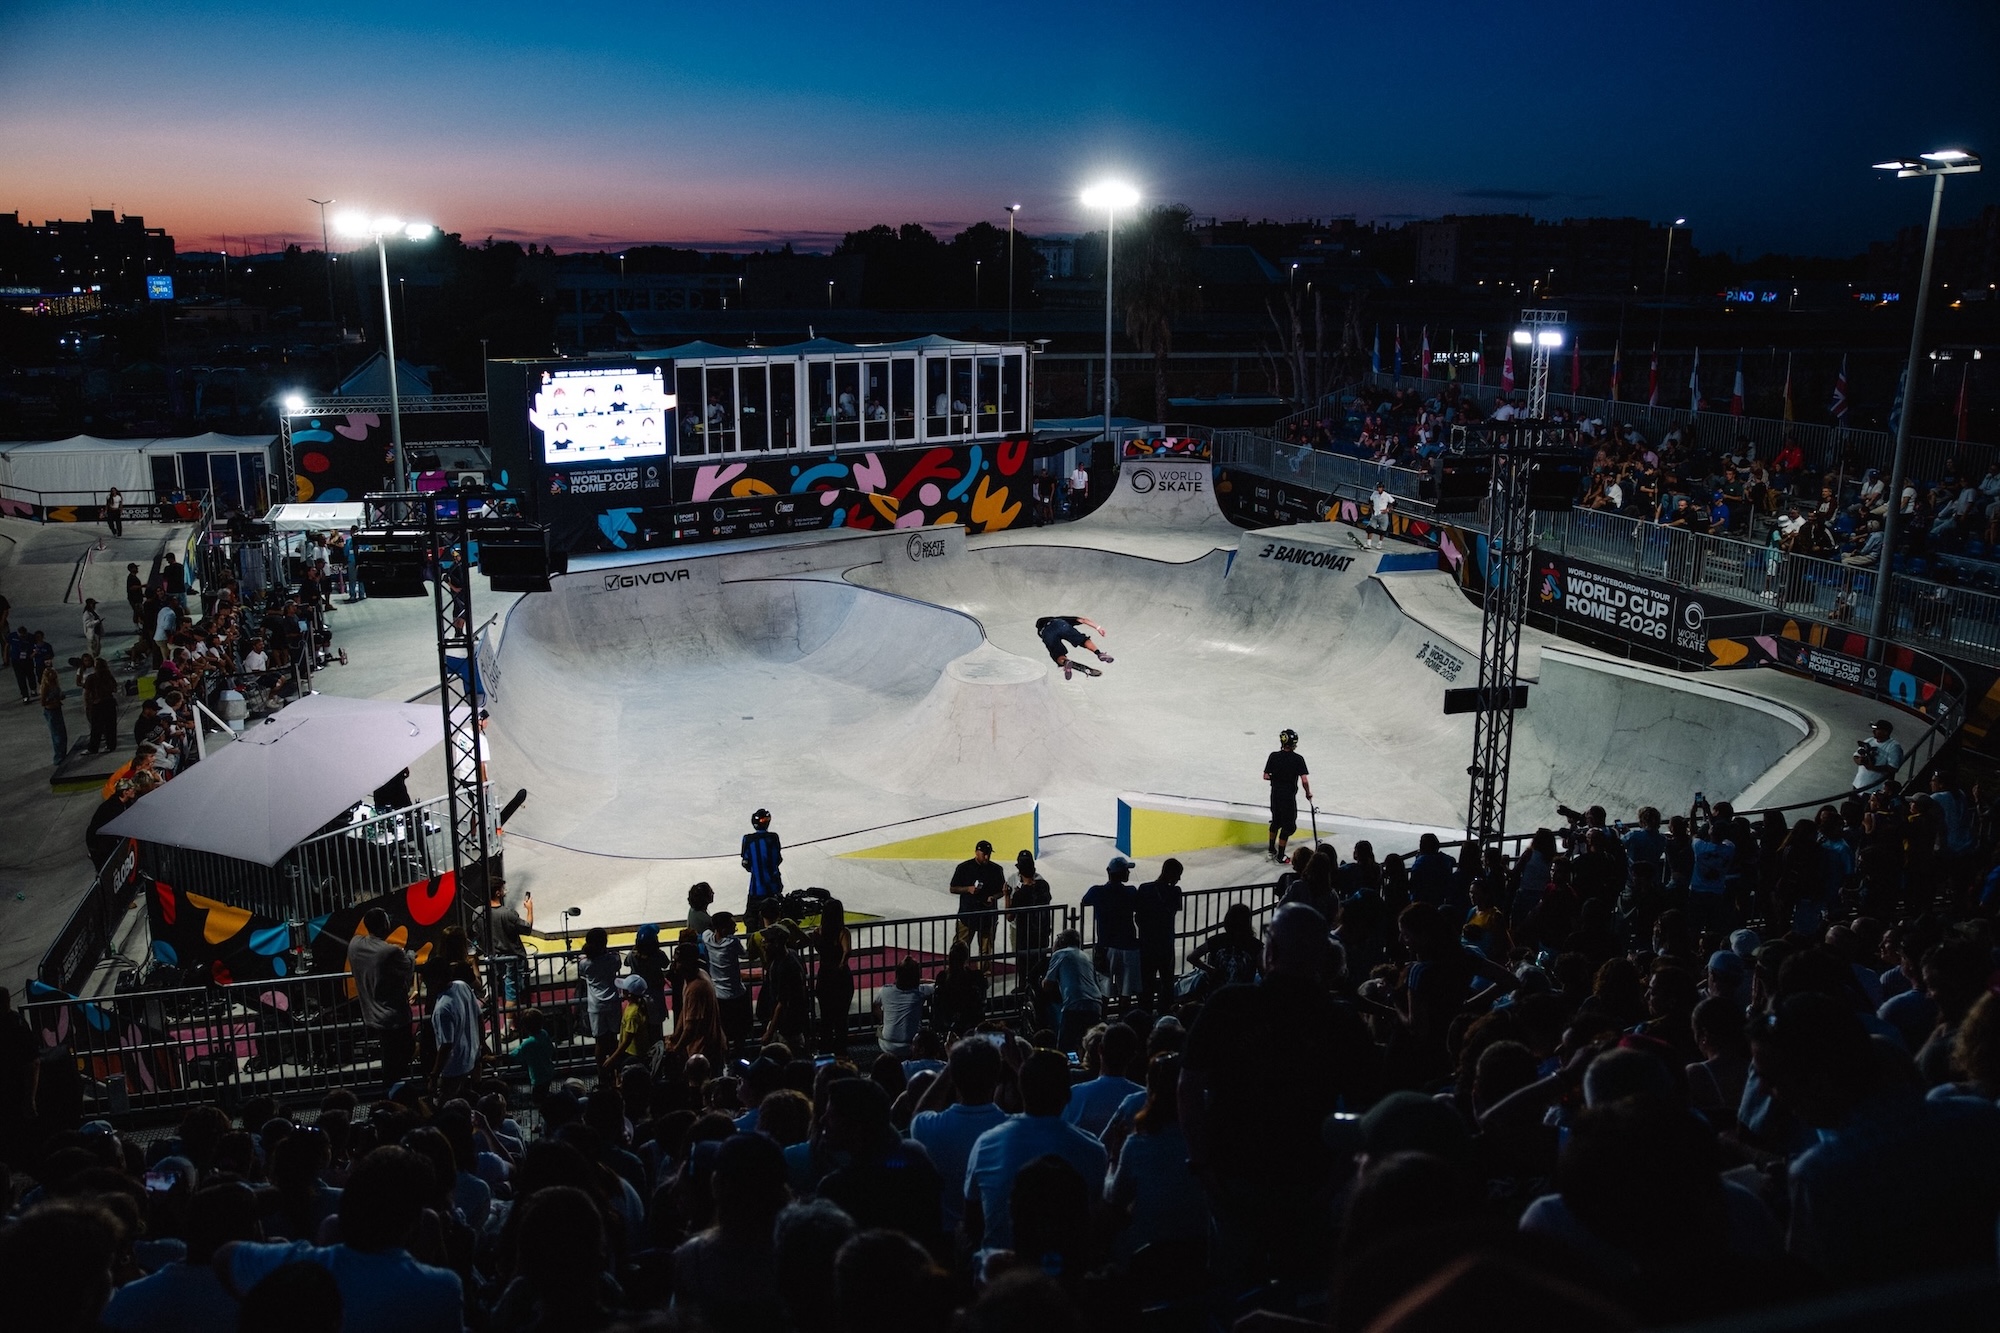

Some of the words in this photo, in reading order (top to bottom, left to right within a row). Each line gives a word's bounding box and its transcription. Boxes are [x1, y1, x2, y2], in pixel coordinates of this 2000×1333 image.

[152, 285, 168, 294] Spin
[570, 474, 612, 485] WORLD
[614, 472, 639, 482] CUP
[1159, 471, 1202, 480] WORLD
[571, 483, 607, 494] ROME
[608, 481, 639, 491] 2026
[1159, 481, 1202, 492] SKATE
[749, 522, 767, 530] ROMA
[922, 540, 945, 552] SKATE
[922, 549, 945, 558] ITALIA
[1274, 545, 1355, 571] BANCOMAT
[620, 569, 690, 588] GIVOVA
[1567, 567, 1592, 580] WORLD
[1593, 573, 1648, 596] SKATEBOARDING
[1650, 589, 1670, 602] TOUR
[1566, 576, 1627, 608] WORLD
[1629, 594, 1670, 619] CUP
[1565, 594, 1618, 624] ROME
[1619, 611, 1668, 640] 2026
[1677, 628, 1706, 643] WORLD
[1677, 637, 1706, 653] SKATE
[1430, 648, 1450, 666] WORLD
[1448, 660, 1462, 673] CUP
[1809, 654, 1841, 669] WORLD
[1841, 664, 1861, 675] CUP
[1423, 657, 1442, 673] ROME
[1439, 668, 1457, 683] 2026
[1808, 662, 1835, 676] ROME
[1835, 670, 1860, 683] 2026
[113, 850, 135, 894] GLOBO
